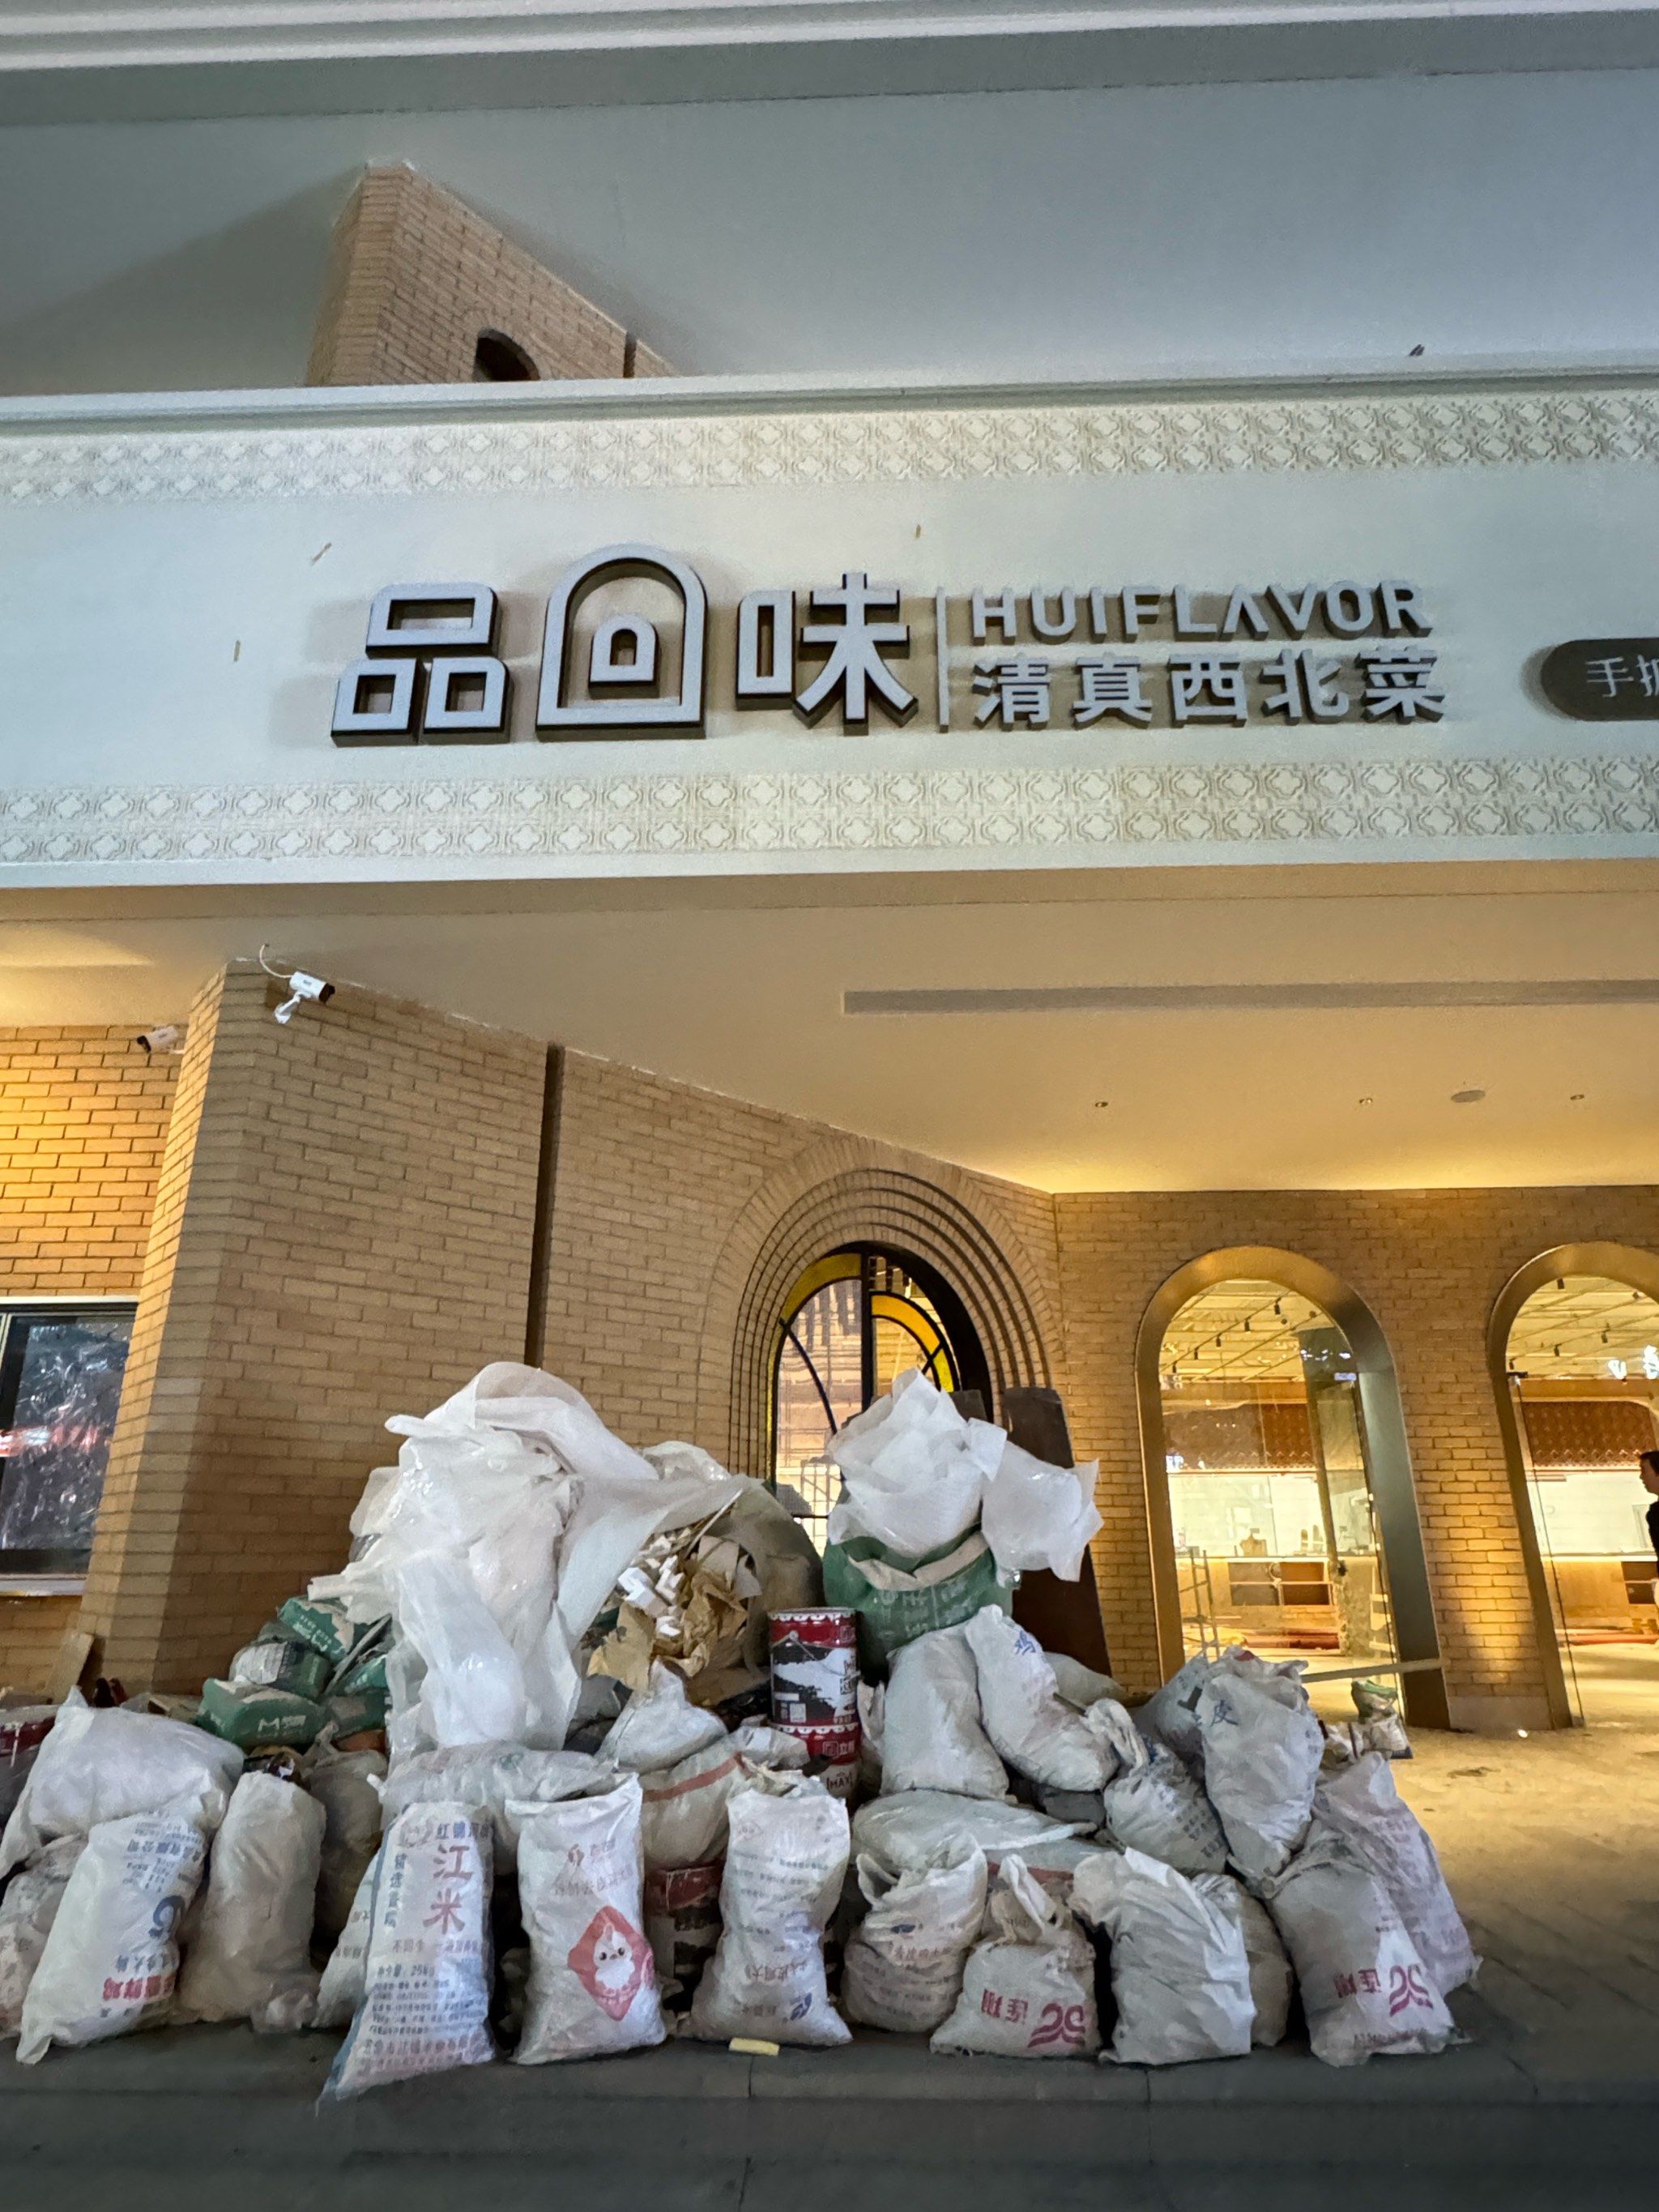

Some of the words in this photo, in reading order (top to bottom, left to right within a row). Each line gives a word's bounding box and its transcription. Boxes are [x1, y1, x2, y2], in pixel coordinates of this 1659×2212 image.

[331, 542, 919, 746] 品回味
[971, 579, 1433, 644] HUIFLAVOR
[971, 647, 1447, 729] 清真西北菜
[423, 1843, 474, 1935] 江米
